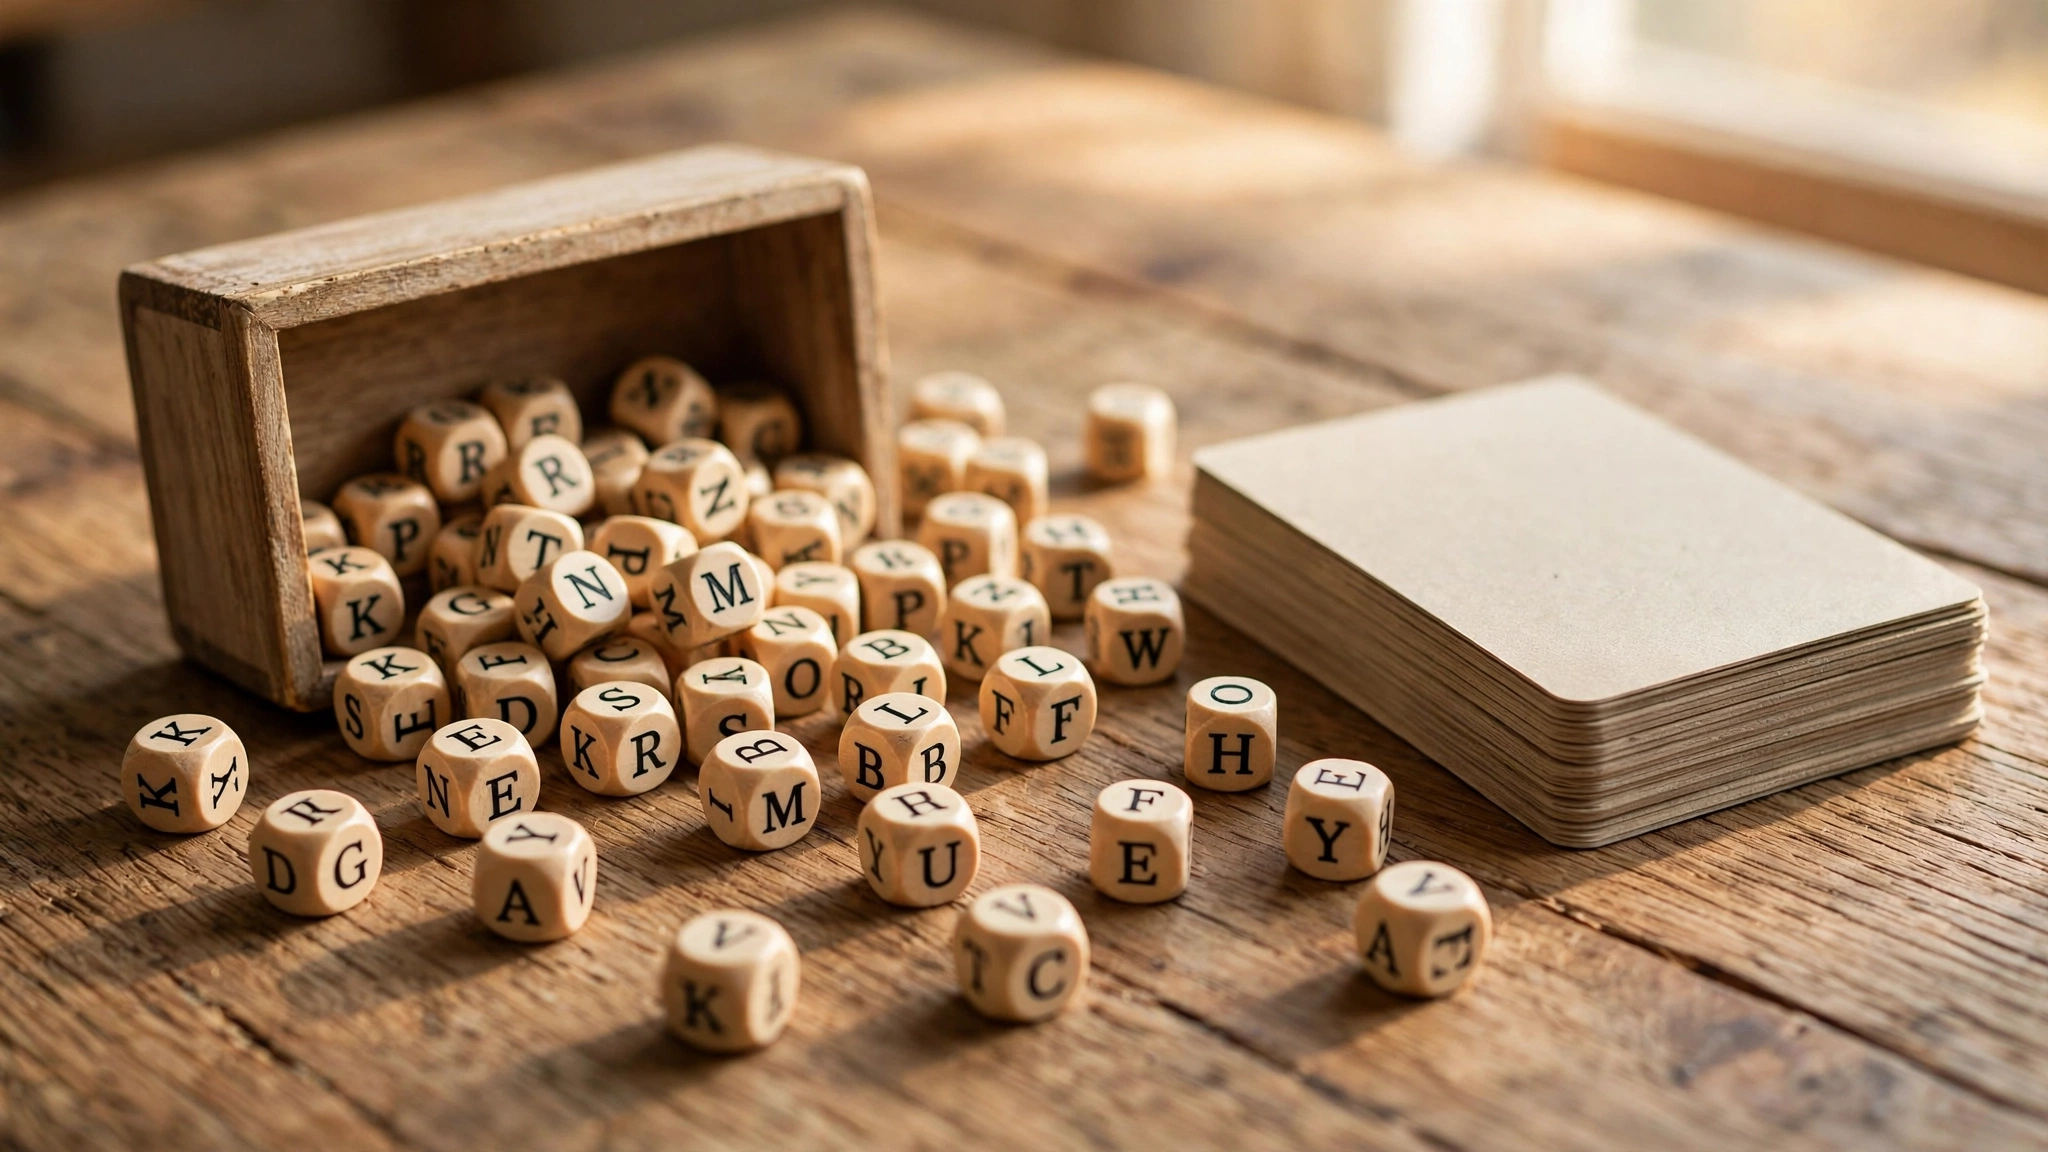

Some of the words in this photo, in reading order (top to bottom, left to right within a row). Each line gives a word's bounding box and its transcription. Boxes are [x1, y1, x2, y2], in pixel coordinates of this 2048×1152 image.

[457, 441, 486, 484] R
[533, 456, 578, 497] R
[386, 519, 418, 562] P
[527, 528, 562, 570] T
[607, 544, 650, 576] P
[323, 553, 367, 576] K
[1062, 561, 1096, 604] T
[449, 592, 492, 616] G
[564, 566, 614, 610] N
[653, 584, 687, 633] M
[700, 562, 754, 613] M
[346, 593, 386, 641] K
[763, 612, 807, 635] N
[892, 590, 925, 629] P
[861, 638, 911, 659] B
[953, 618, 985, 667] K
[1119, 627, 1170, 670] W
[361, 653, 419, 680] K
[784, 658, 821, 700] O
[1015, 656, 1064, 676] L
[496, 696, 537, 735] D
[599, 687, 641, 711] S
[874, 702, 929, 725] L
[991, 689, 1014, 736] F
[1210, 684, 1253, 704] O
[150, 721, 212, 746] K
[344, 693, 364, 740] S
[446, 724, 502, 752] E
[1050, 694, 1082, 744] F
[570, 725, 600, 780] K
[630, 730, 666, 779] R
[735, 738, 788, 764] B
[854, 741, 885, 790] B
[920, 742, 946, 784] B
[1207, 733, 1255, 775] H
[137, 773, 180, 817] K
[424, 764, 449, 818] N
[486, 770, 521, 821] E
[1123, 787, 1165, 812] F
[1314, 768, 1367, 791] E
[280, 797, 343, 827] R
[761, 782, 806, 834] M
[892, 790, 949, 818] R
[505, 823, 558, 844] Y
[1305, 816, 1351, 863] Y
[262, 846, 296, 895] D
[334, 839, 368, 889] G
[573, 857, 588, 905] V
[917, 840, 963, 888] U
[1117, 840, 1158, 886] E
[496, 879, 542, 927] A
[991, 892, 1037, 920] V
[711, 920, 758, 949] V
[1365, 920, 1402, 977] A
[1027, 948, 1068, 1001] C
[682, 979, 724, 1034] K
